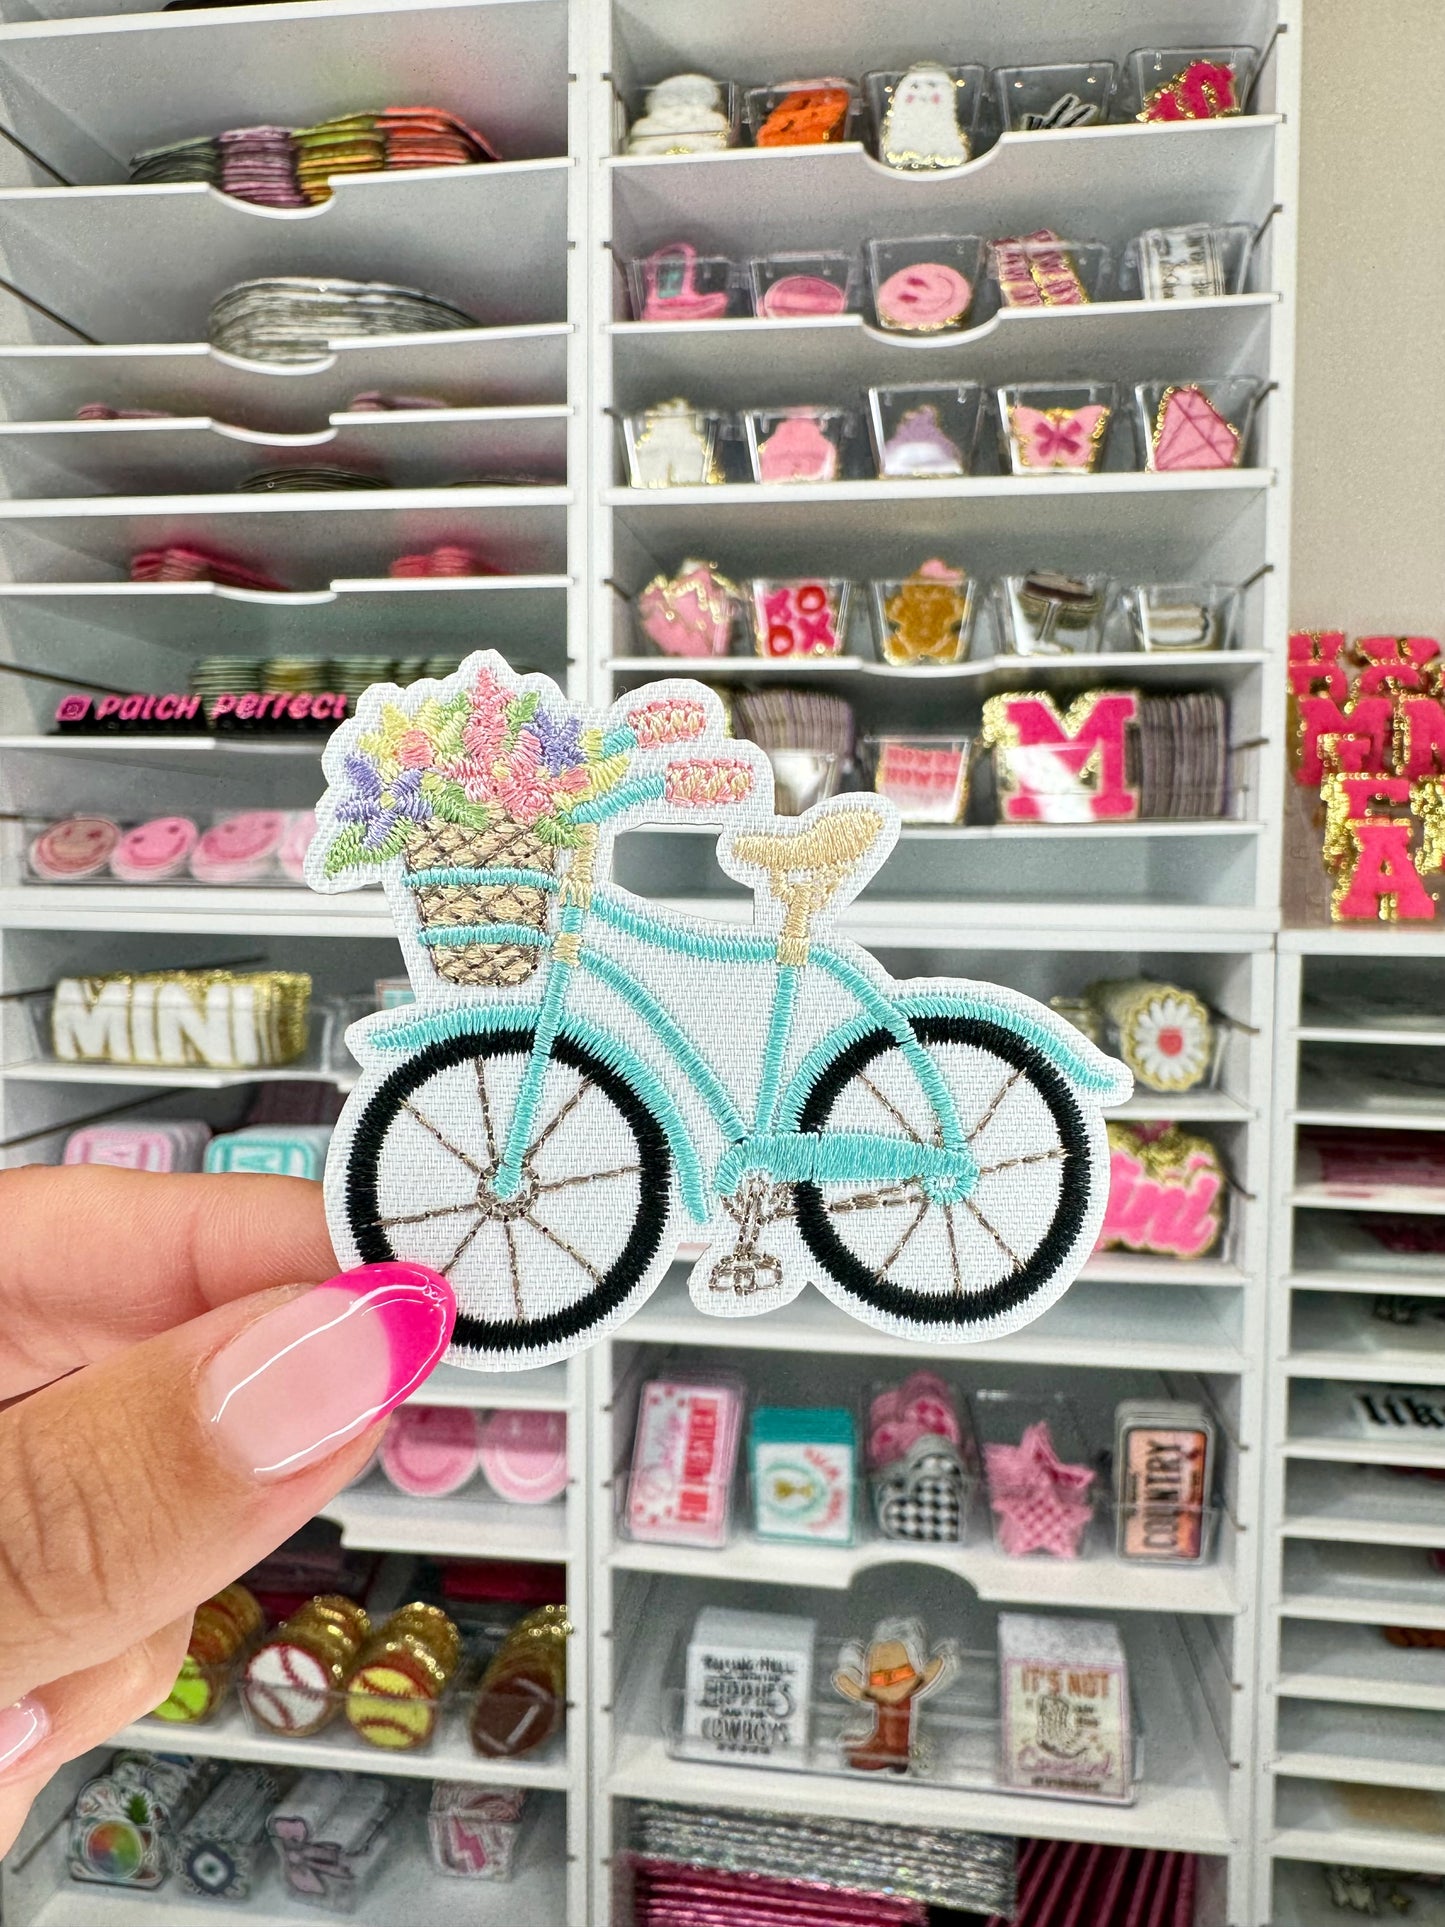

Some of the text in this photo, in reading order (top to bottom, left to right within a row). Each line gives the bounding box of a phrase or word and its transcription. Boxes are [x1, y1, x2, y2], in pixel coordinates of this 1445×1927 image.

[54, 977, 261, 1067] MINI
[1143, 1439, 1181, 1548] COUNTRY
[1066, 1671, 1109, 1698] NOT
[701, 1717, 789, 1743] COWBOYS
